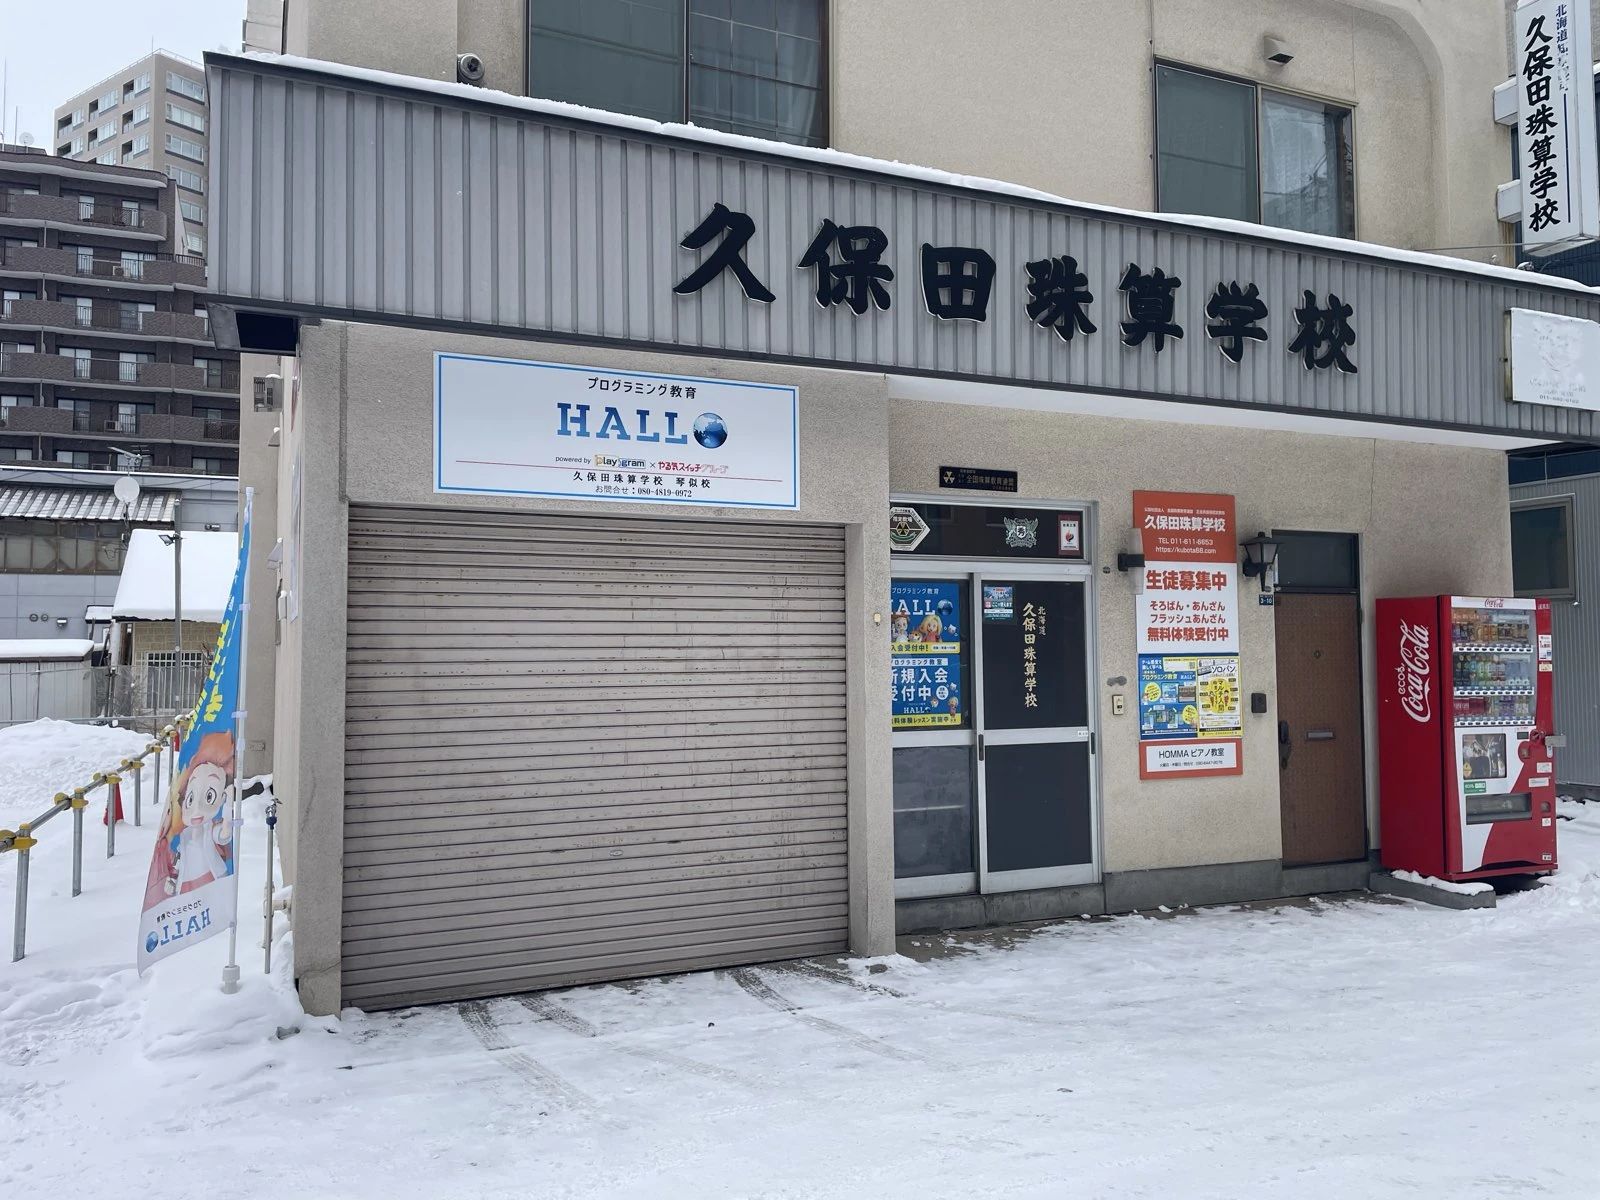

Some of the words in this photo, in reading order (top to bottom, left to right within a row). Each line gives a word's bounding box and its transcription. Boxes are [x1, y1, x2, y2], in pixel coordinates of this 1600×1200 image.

[1522, 14, 1561, 233] 久保田珠算学校
[673, 202, 1359, 376] 久保田珠算学校
[588, 377, 697, 400] プログラミング教育
[555, 456, 582, 464] powered
[583, 457, 592, 465] by
[573, 470, 664, 486] 久保田珠算学校
[676, 477, 711, 489] 琴似校
[1144, 514, 1226, 532] 久保田珠算学校
[1158, 537, 1169, 545] TEL
[1146, 570, 1228, 592] 生徒募集中
[891, 599, 936, 615] ALL
[1150, 600, 1226, 612] そろばん・あんざん
[1150, 613, 1226, 624] フラッシュあんざん
[1147, 626, 1229, 642] 無料体験受付中
[1022, 602, 1038, 708] 久保田珠算学校
[1400, 618, 1431, 723] Coca-Cola
[891, 715, 949, 724] 料体験レッスン実施中
[1158, 749, 1190, 759] HOMMA
[1190, 747, 1225, 758] ピアノ教室
